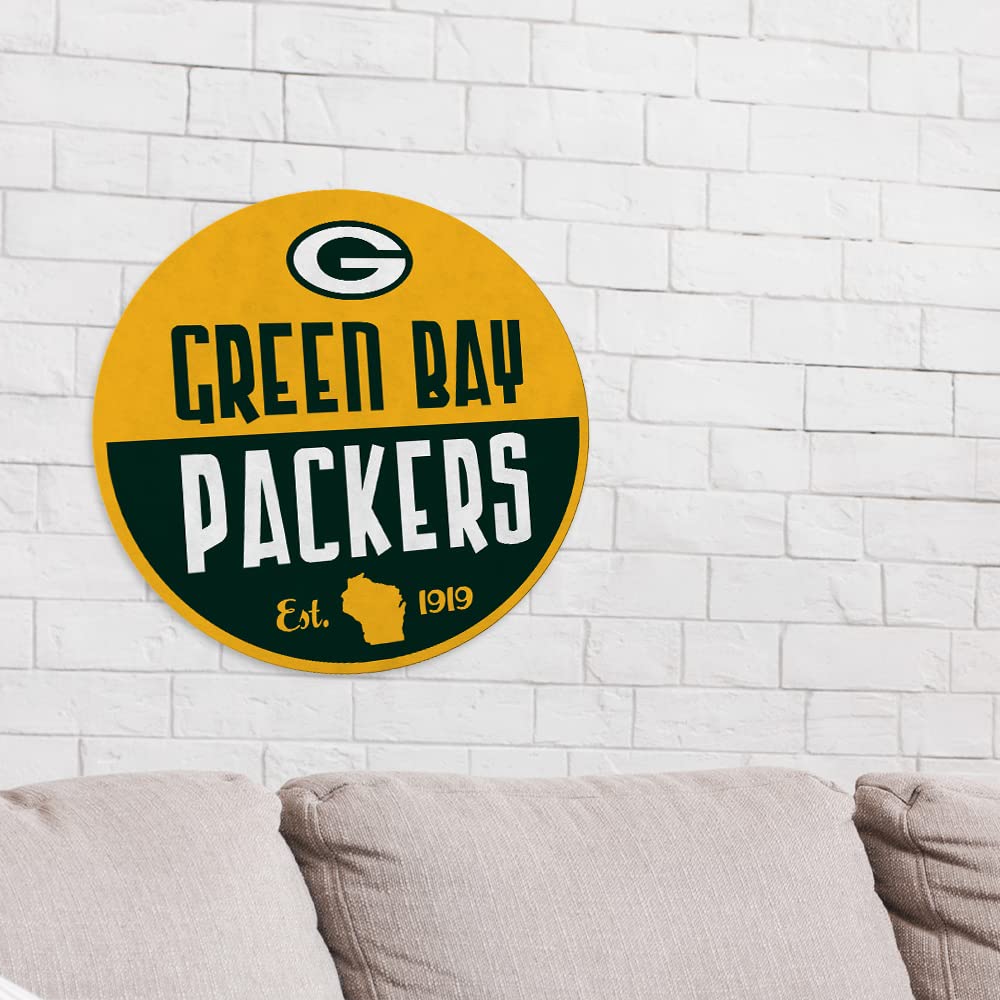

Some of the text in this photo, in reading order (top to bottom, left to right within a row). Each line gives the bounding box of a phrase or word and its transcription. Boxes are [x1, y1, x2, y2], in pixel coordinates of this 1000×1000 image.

[292, 225, 407, 295] G
[170, 319, 524, 425] GREEN BAY
[180, 431, 533, 574] PACKERS
[276, 585, 474, 632] Est. 1919
